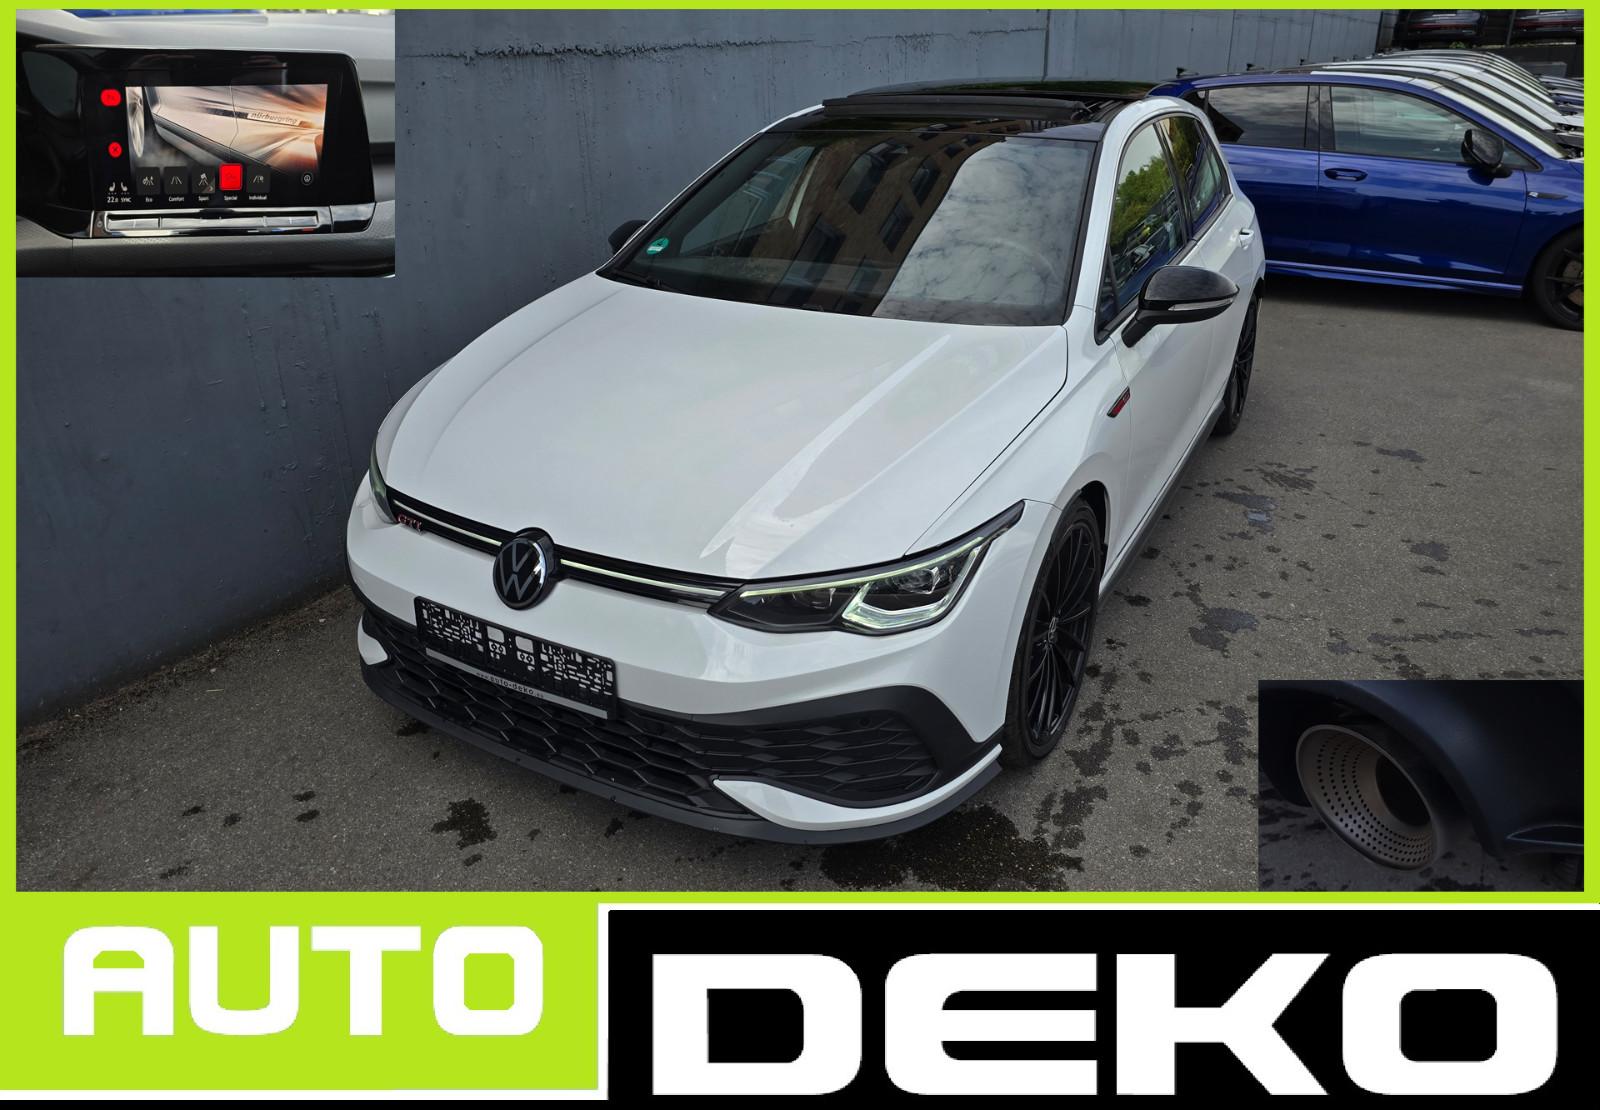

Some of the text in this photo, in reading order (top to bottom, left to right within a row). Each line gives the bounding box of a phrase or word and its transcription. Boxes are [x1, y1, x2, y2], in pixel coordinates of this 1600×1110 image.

[223, 194, 238, 202] Special
[248, 193, 268, 201] Individual
[398, 514, 422, 531] GTI
